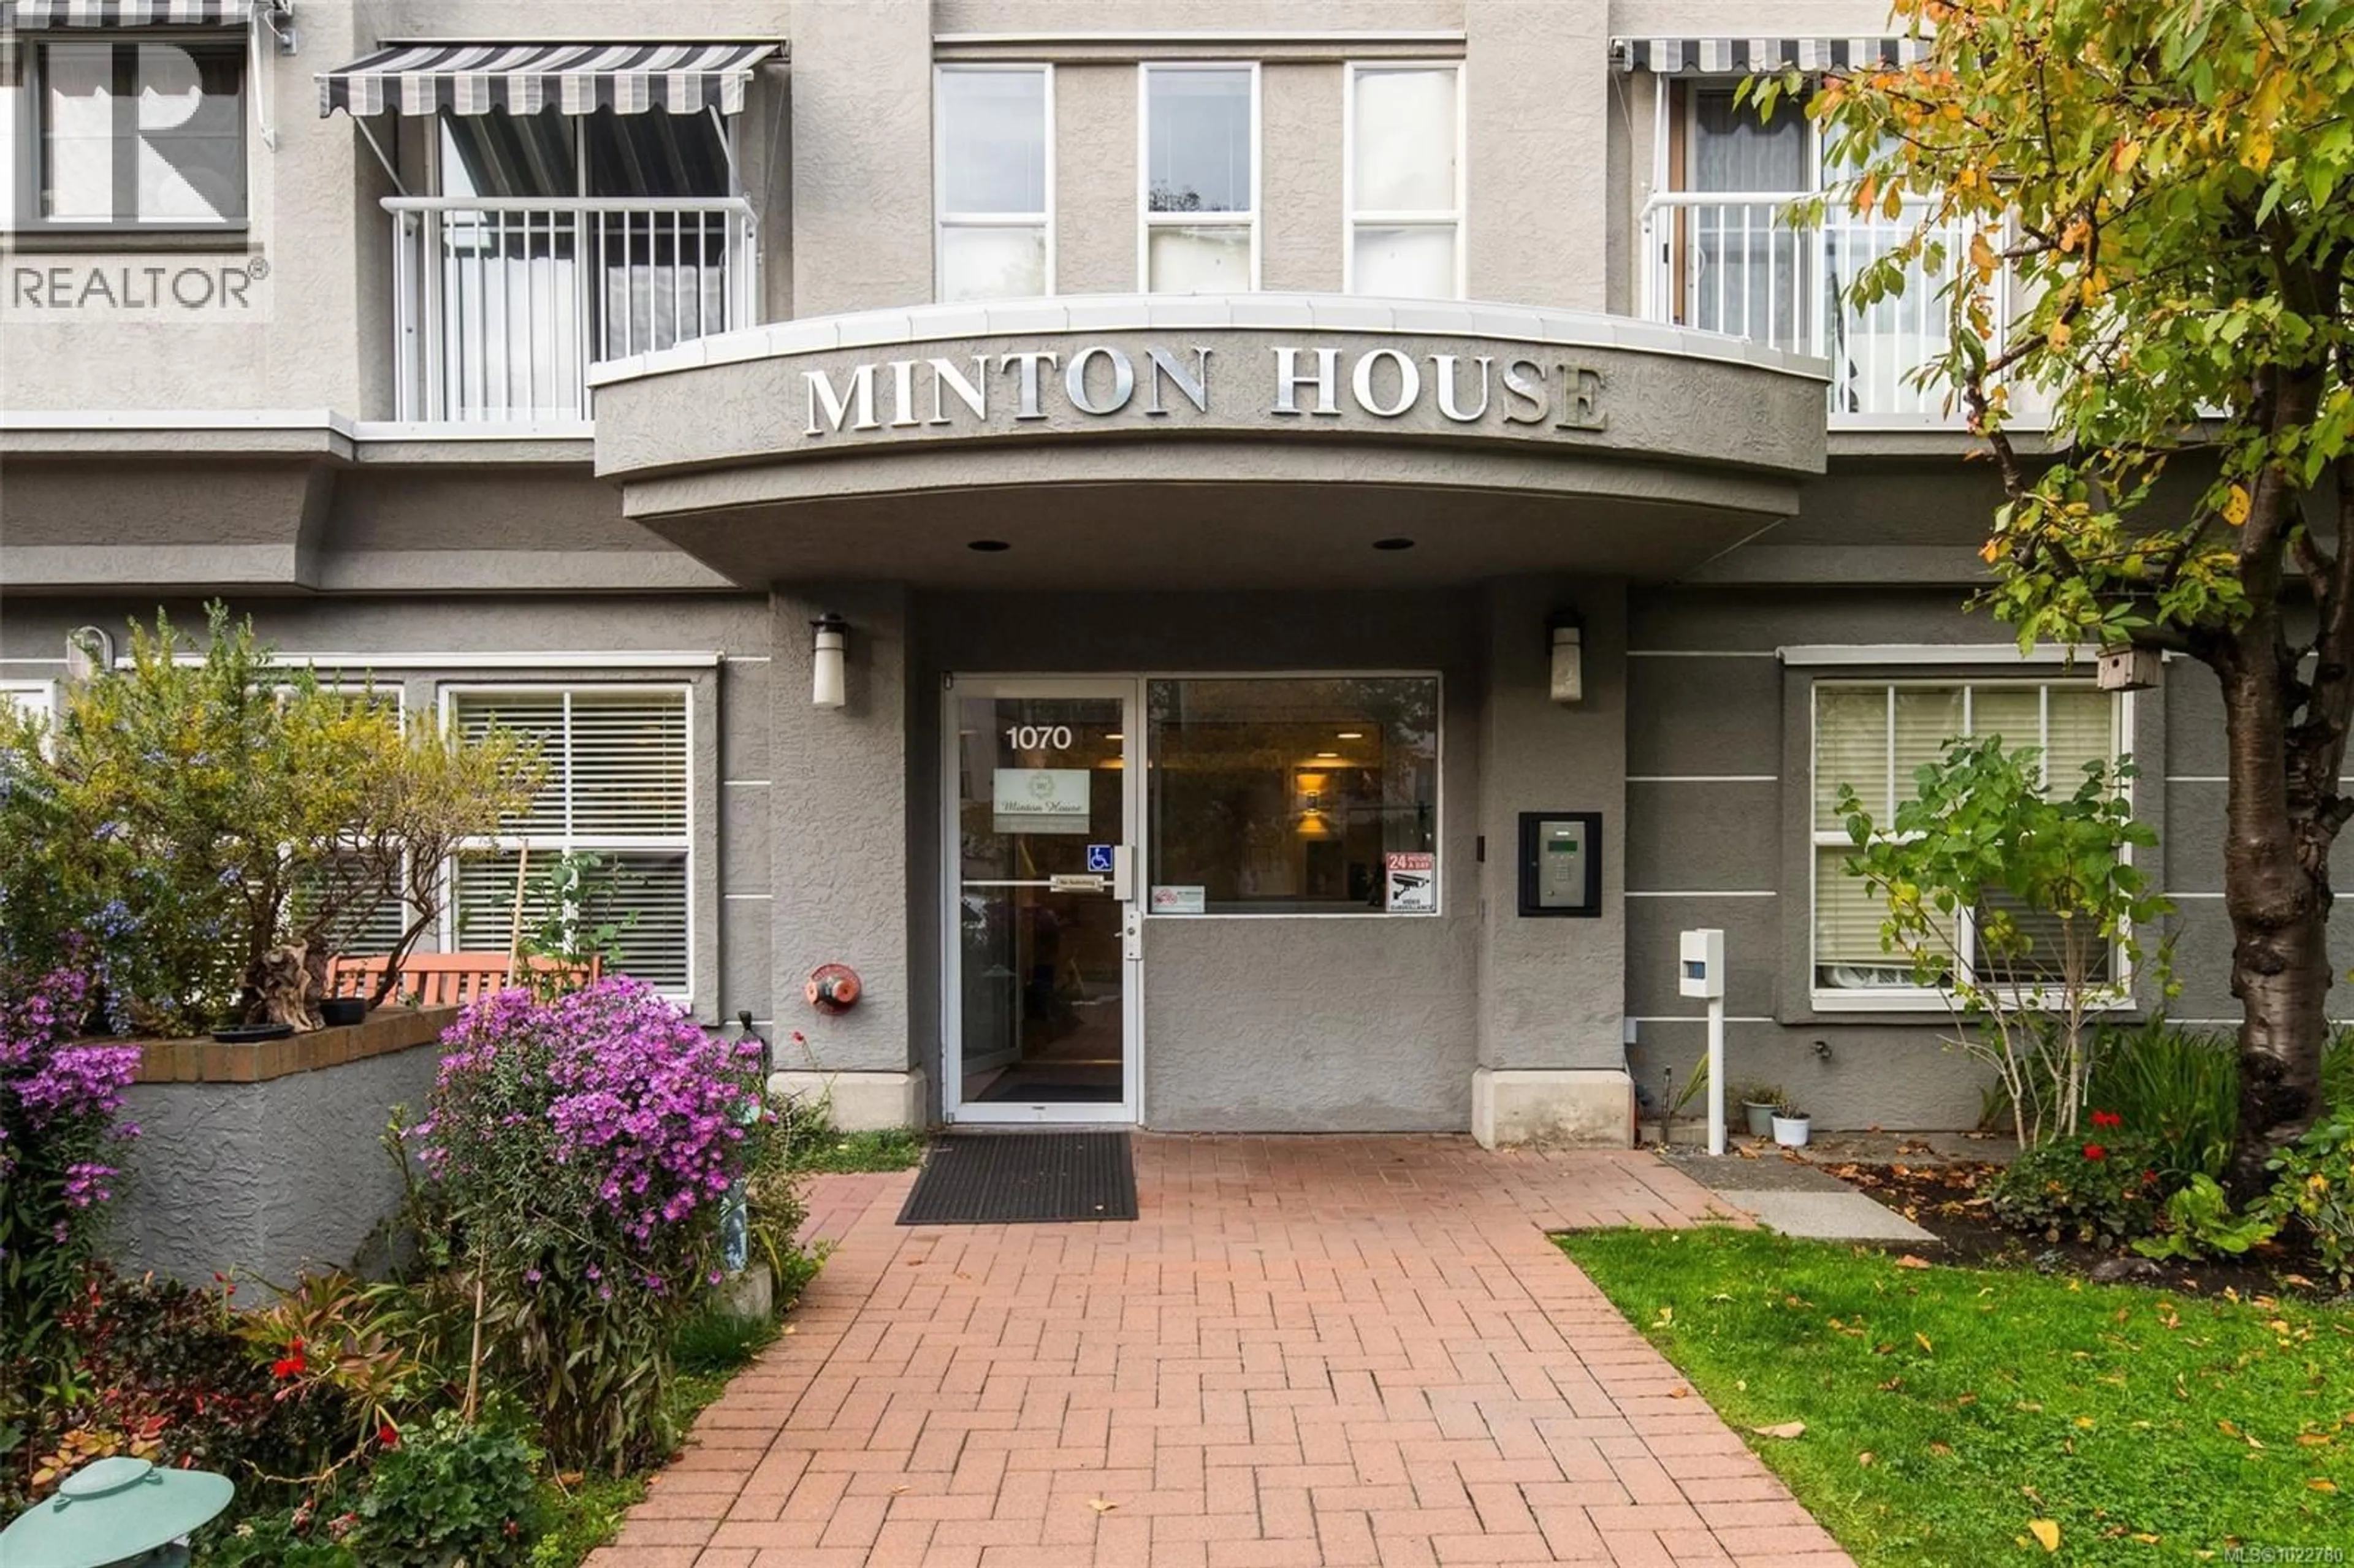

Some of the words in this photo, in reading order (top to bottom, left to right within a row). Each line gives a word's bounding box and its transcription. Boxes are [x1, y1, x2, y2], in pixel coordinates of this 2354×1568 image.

[802, 346, 1213, 436] MINTON
[1269, 347, 1609, 432] HOUSE
[1006, 726, 1072, 750] 1070
[1389, 855, 1406, 869] 24
